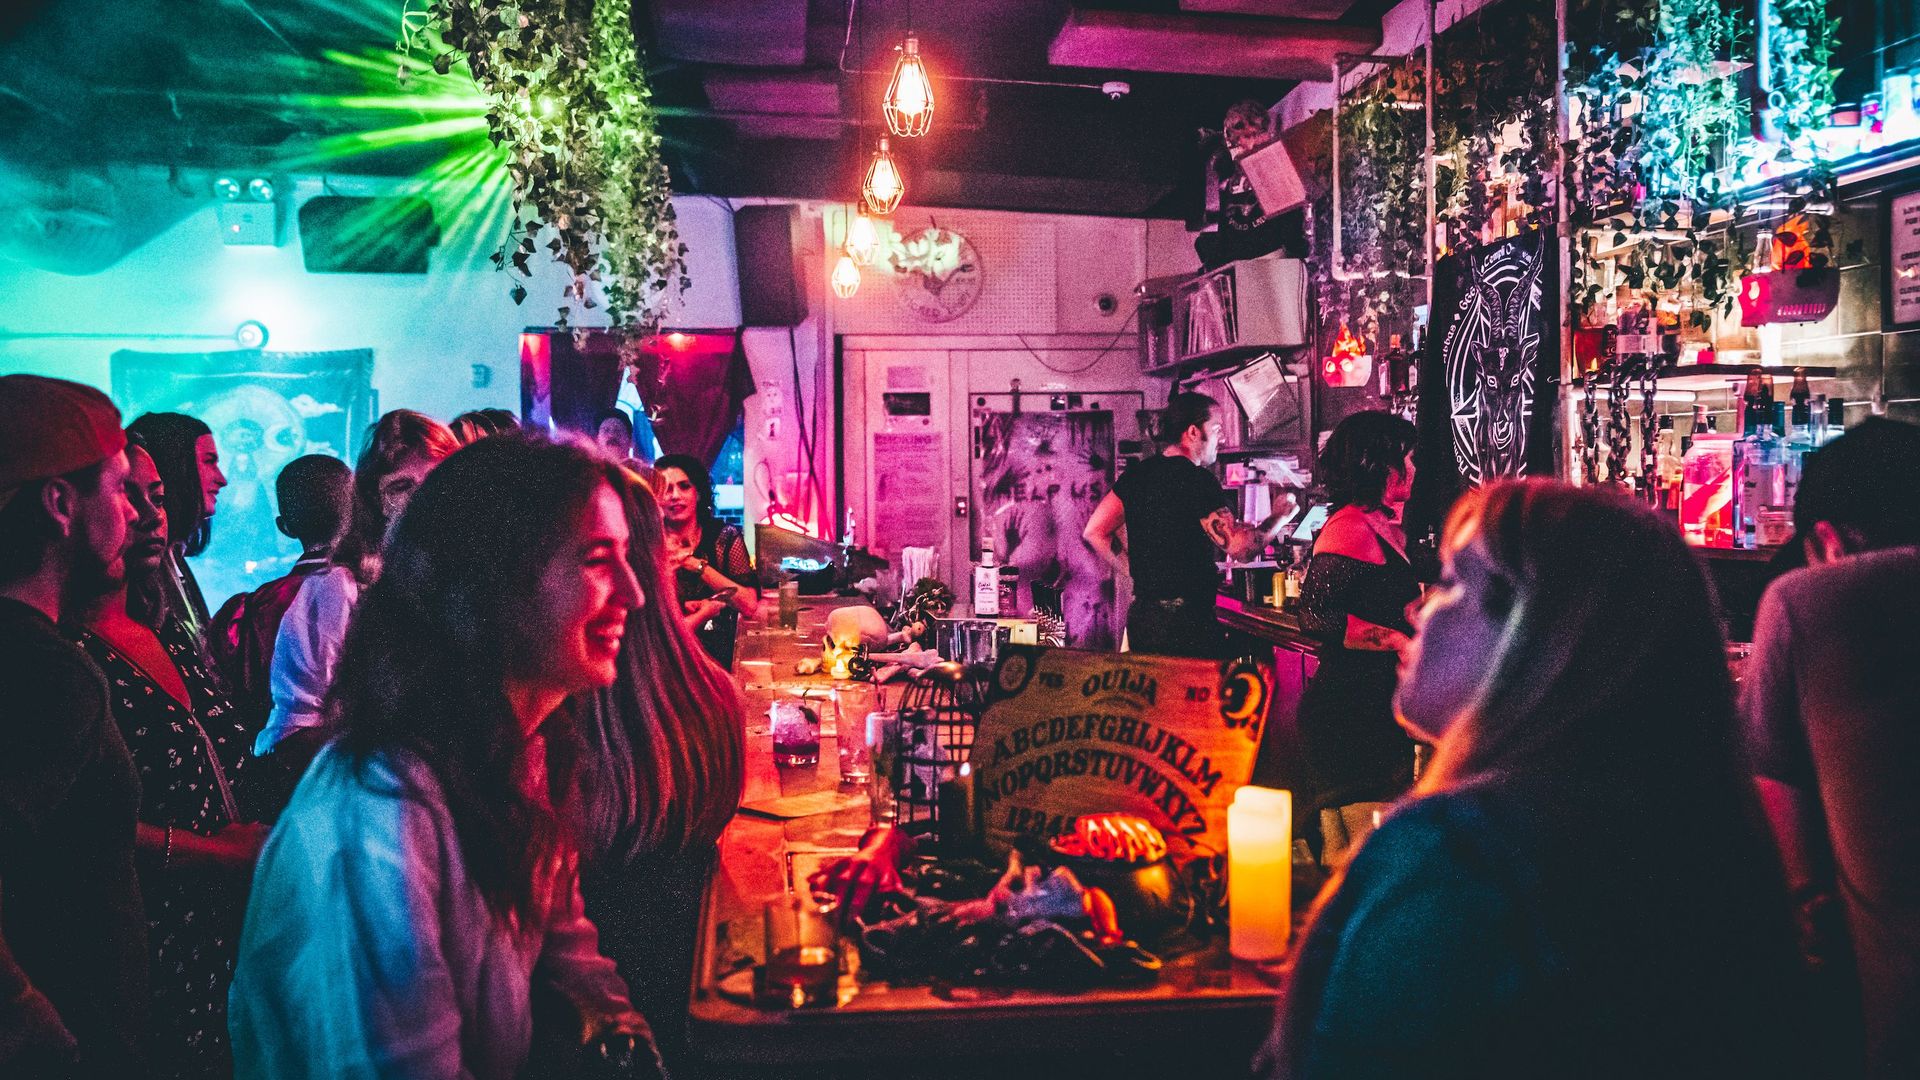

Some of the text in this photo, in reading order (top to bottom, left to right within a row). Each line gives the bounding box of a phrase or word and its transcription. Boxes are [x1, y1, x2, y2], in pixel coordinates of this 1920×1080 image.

[1081, 667, 1158, 706] OUIJA
[1184, 684, 1212, 704] NO
[993, 712, 1223, 798] ABCDEFGHIJKLM
